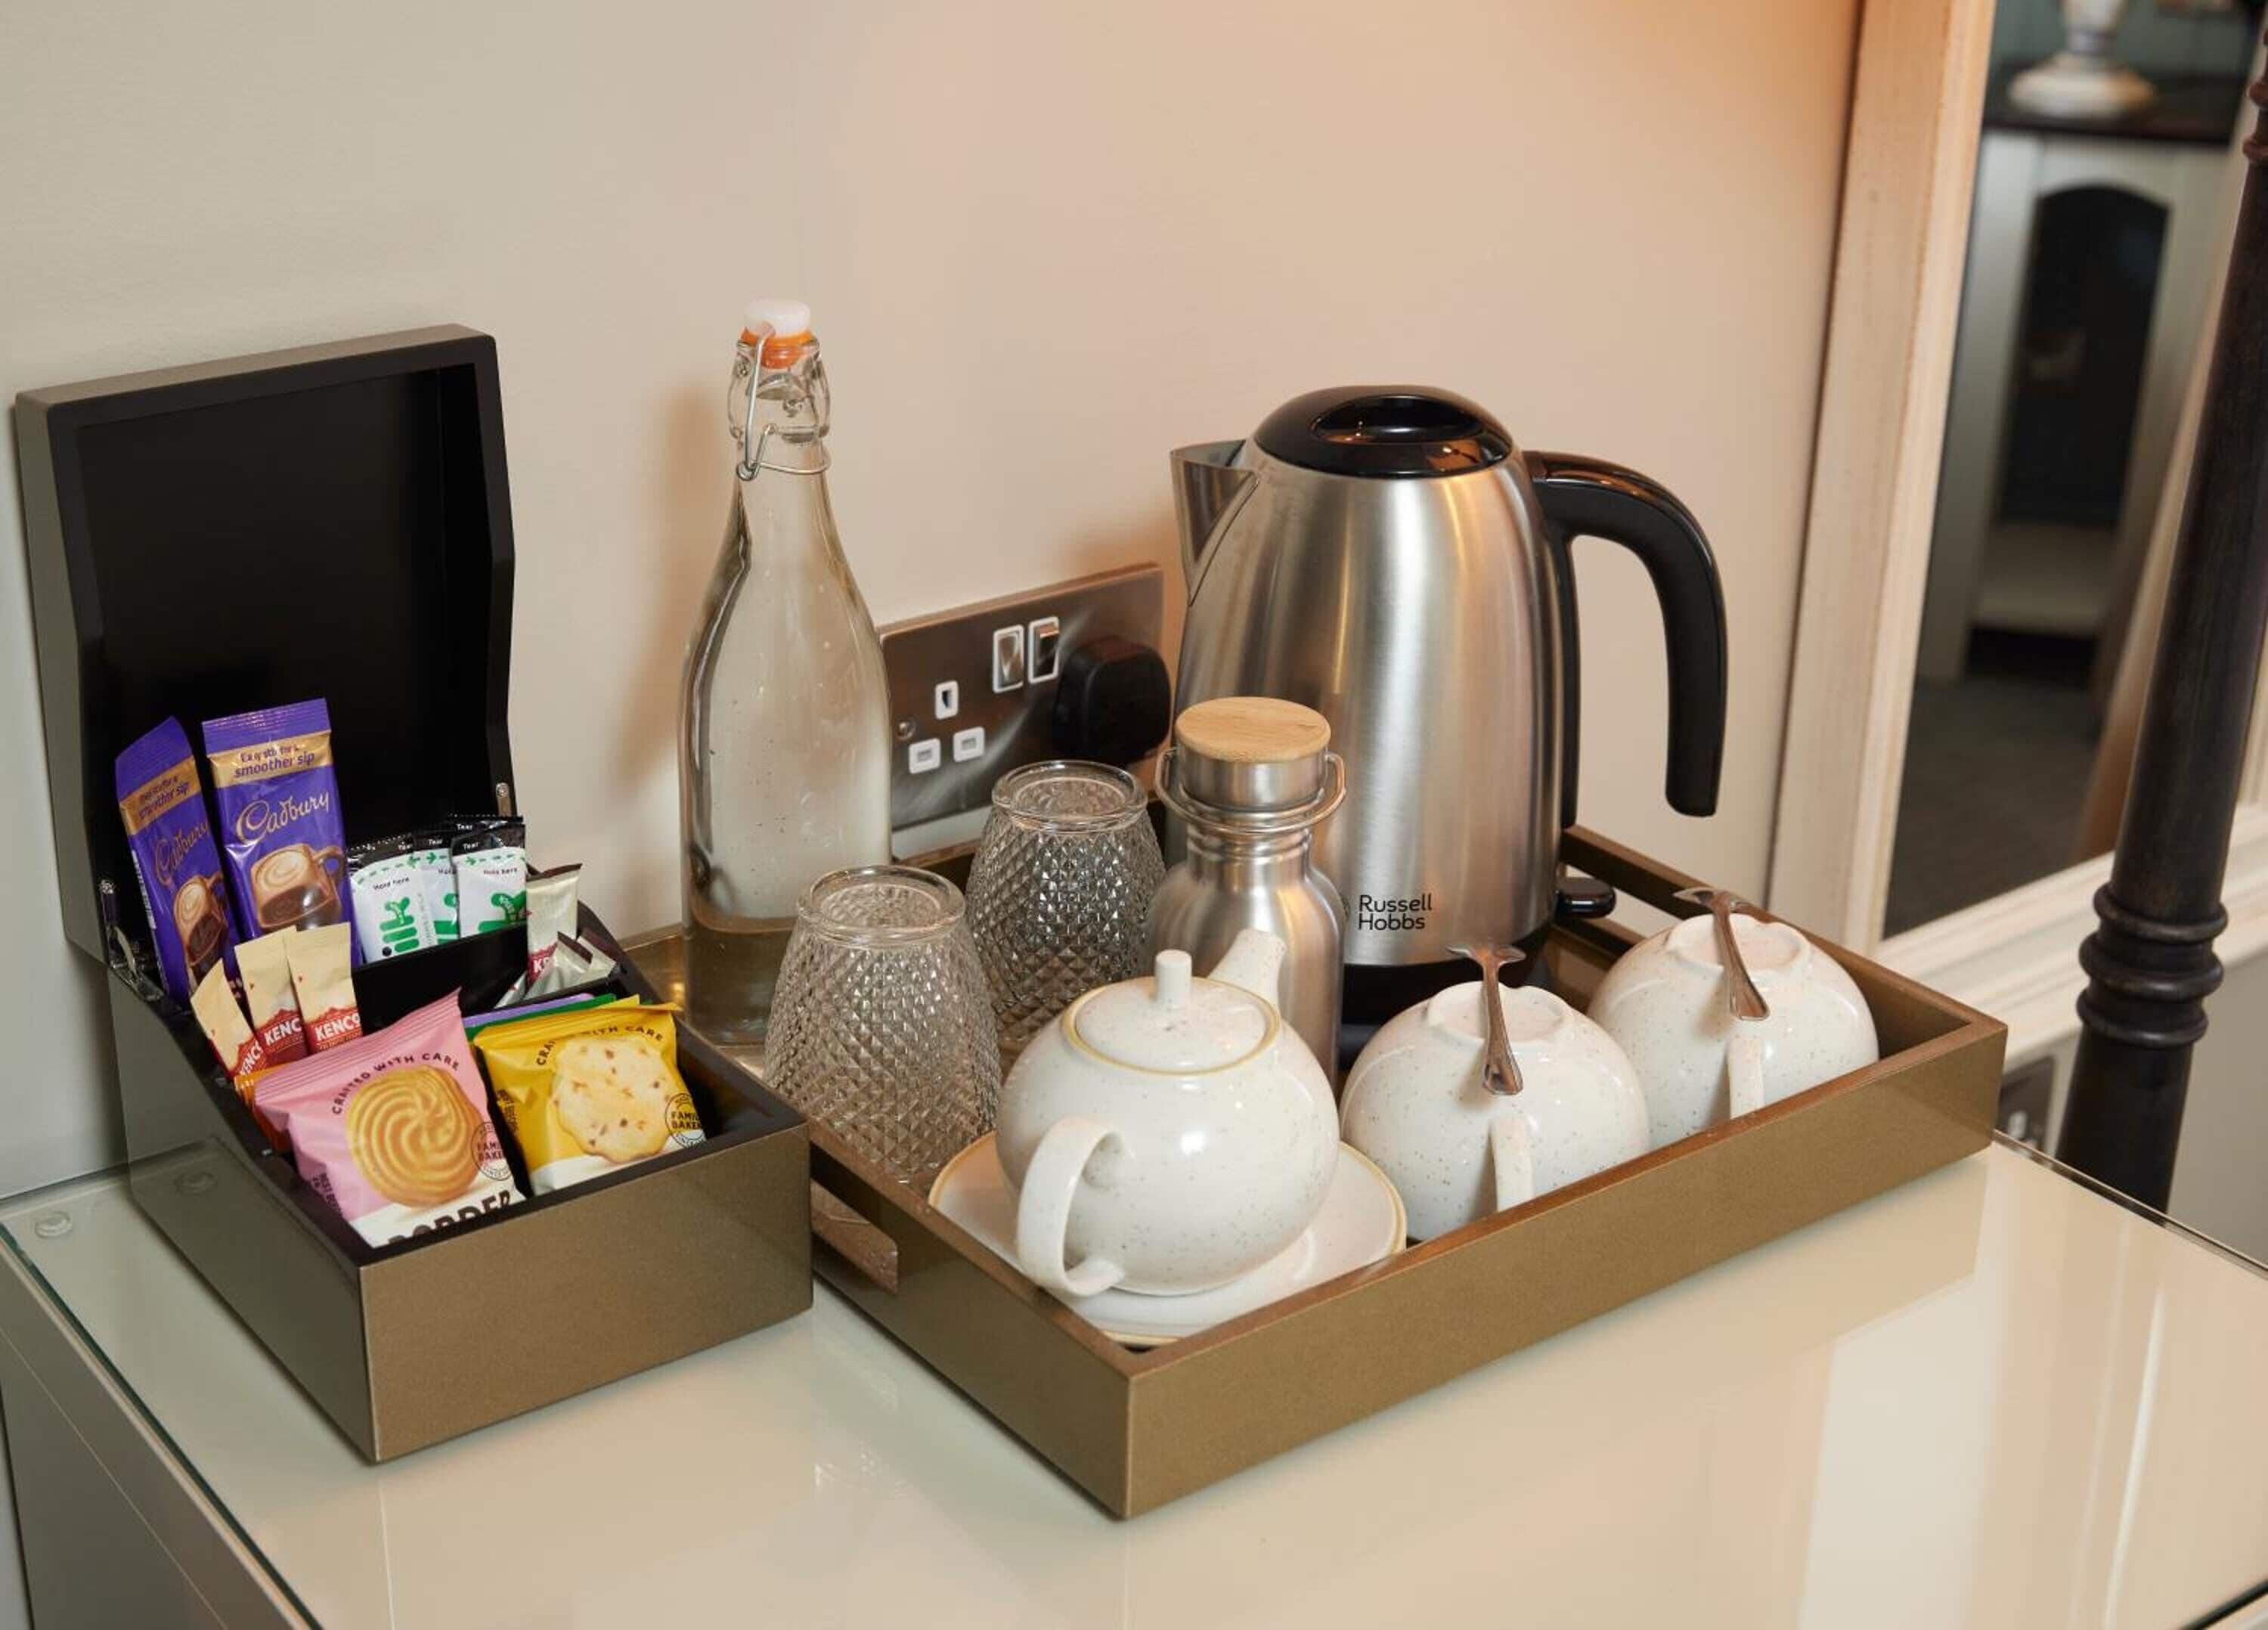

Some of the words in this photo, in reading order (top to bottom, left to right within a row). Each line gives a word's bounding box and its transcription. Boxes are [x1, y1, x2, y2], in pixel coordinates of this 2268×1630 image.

[235, 754, 294, 778] smoother
[297, 750, 315, 766] sip
[236, 792, 329, 843] Cadbury
[457, 823, 473, 831] Tear
[463, 841, 479, 851] Tear
[1359, 893, 1433, 913] Russell
[1358, 913, 1426, 931] Hobbs
[265, 1018, 302, 1046] KENC
[625, 1024, 664, 1042] CARE
[373, 1055, 415, 1072] WITH
[421, 1052, 460, 1071] CARE
